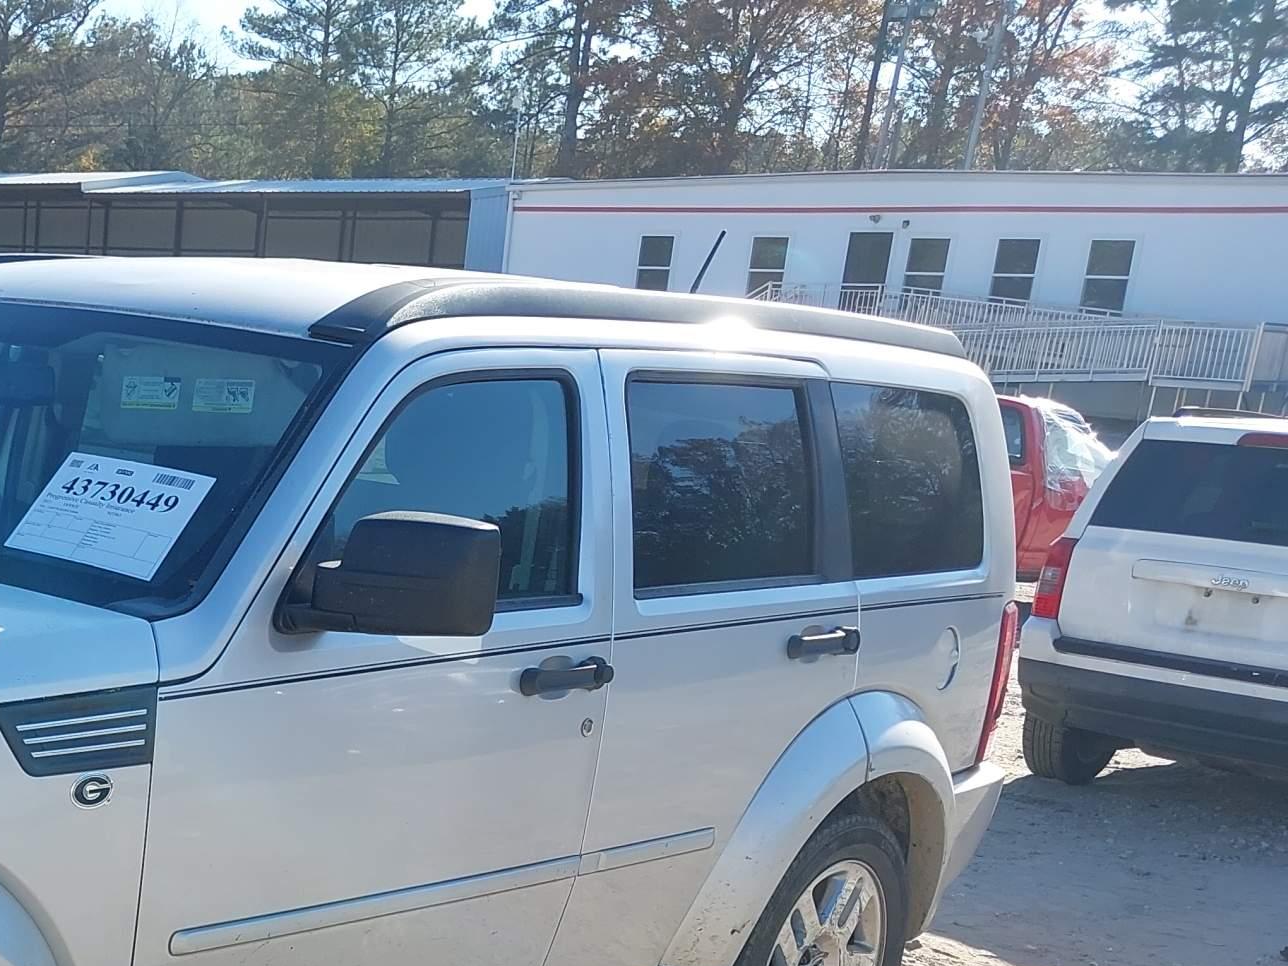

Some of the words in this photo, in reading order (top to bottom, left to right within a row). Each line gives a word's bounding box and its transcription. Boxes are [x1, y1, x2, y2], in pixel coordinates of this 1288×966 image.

[62, 477, 179, 513] 43730449
[1211, 575, 1249, 591] Jeep
[72, 774, 113, 808] G
